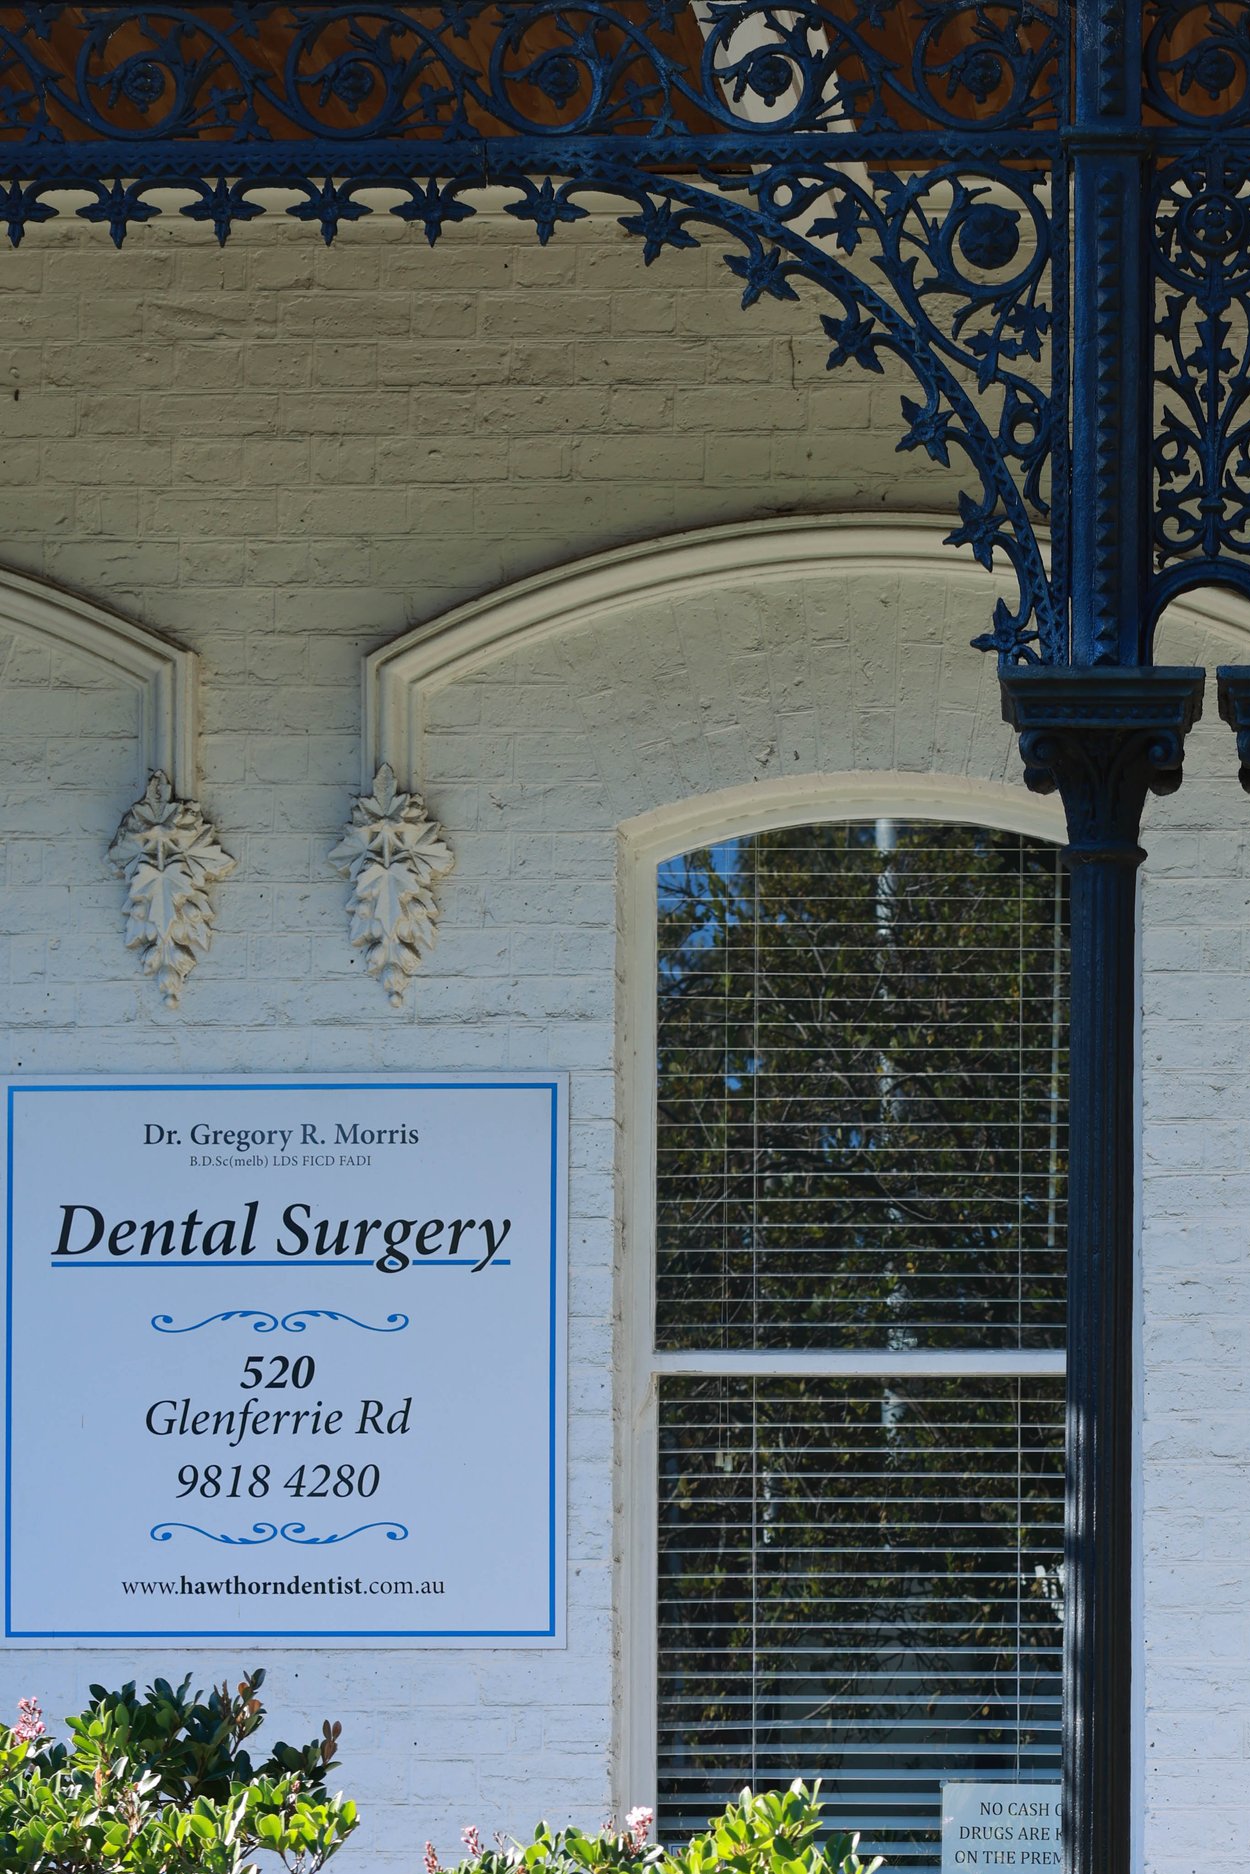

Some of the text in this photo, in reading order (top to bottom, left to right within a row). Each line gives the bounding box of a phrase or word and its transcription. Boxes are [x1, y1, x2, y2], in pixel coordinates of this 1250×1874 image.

[144, 1124, 419, 1151] Dr. Gregory R. Morris
[273, 1156, 298, 1167] LDS
[303, 1156, 335, 1167] FICD
[339, 1156, 371, 1167] FADI
[51, 1201, 512, 1273] Dental Surgery
[240, 1355, 315, 1389] 520
[145, 1397, 412, 1447] Glenferrie Rd
[176, 1463, 380, 1499] 9818 4280
[122, 1576, 445, 1595] www.hawthorndentist.com.au
[980, 1802, 1003, 1815] NO
[1008, 1803, 1049, 1816] CASH
[960, 1826, 1013, 1840] DRUGS
[1018, 1827, 1050, 1841] ARE
[955, 1850, 977, 1863] ON
[983, 1851, 1015, 1864] THE
